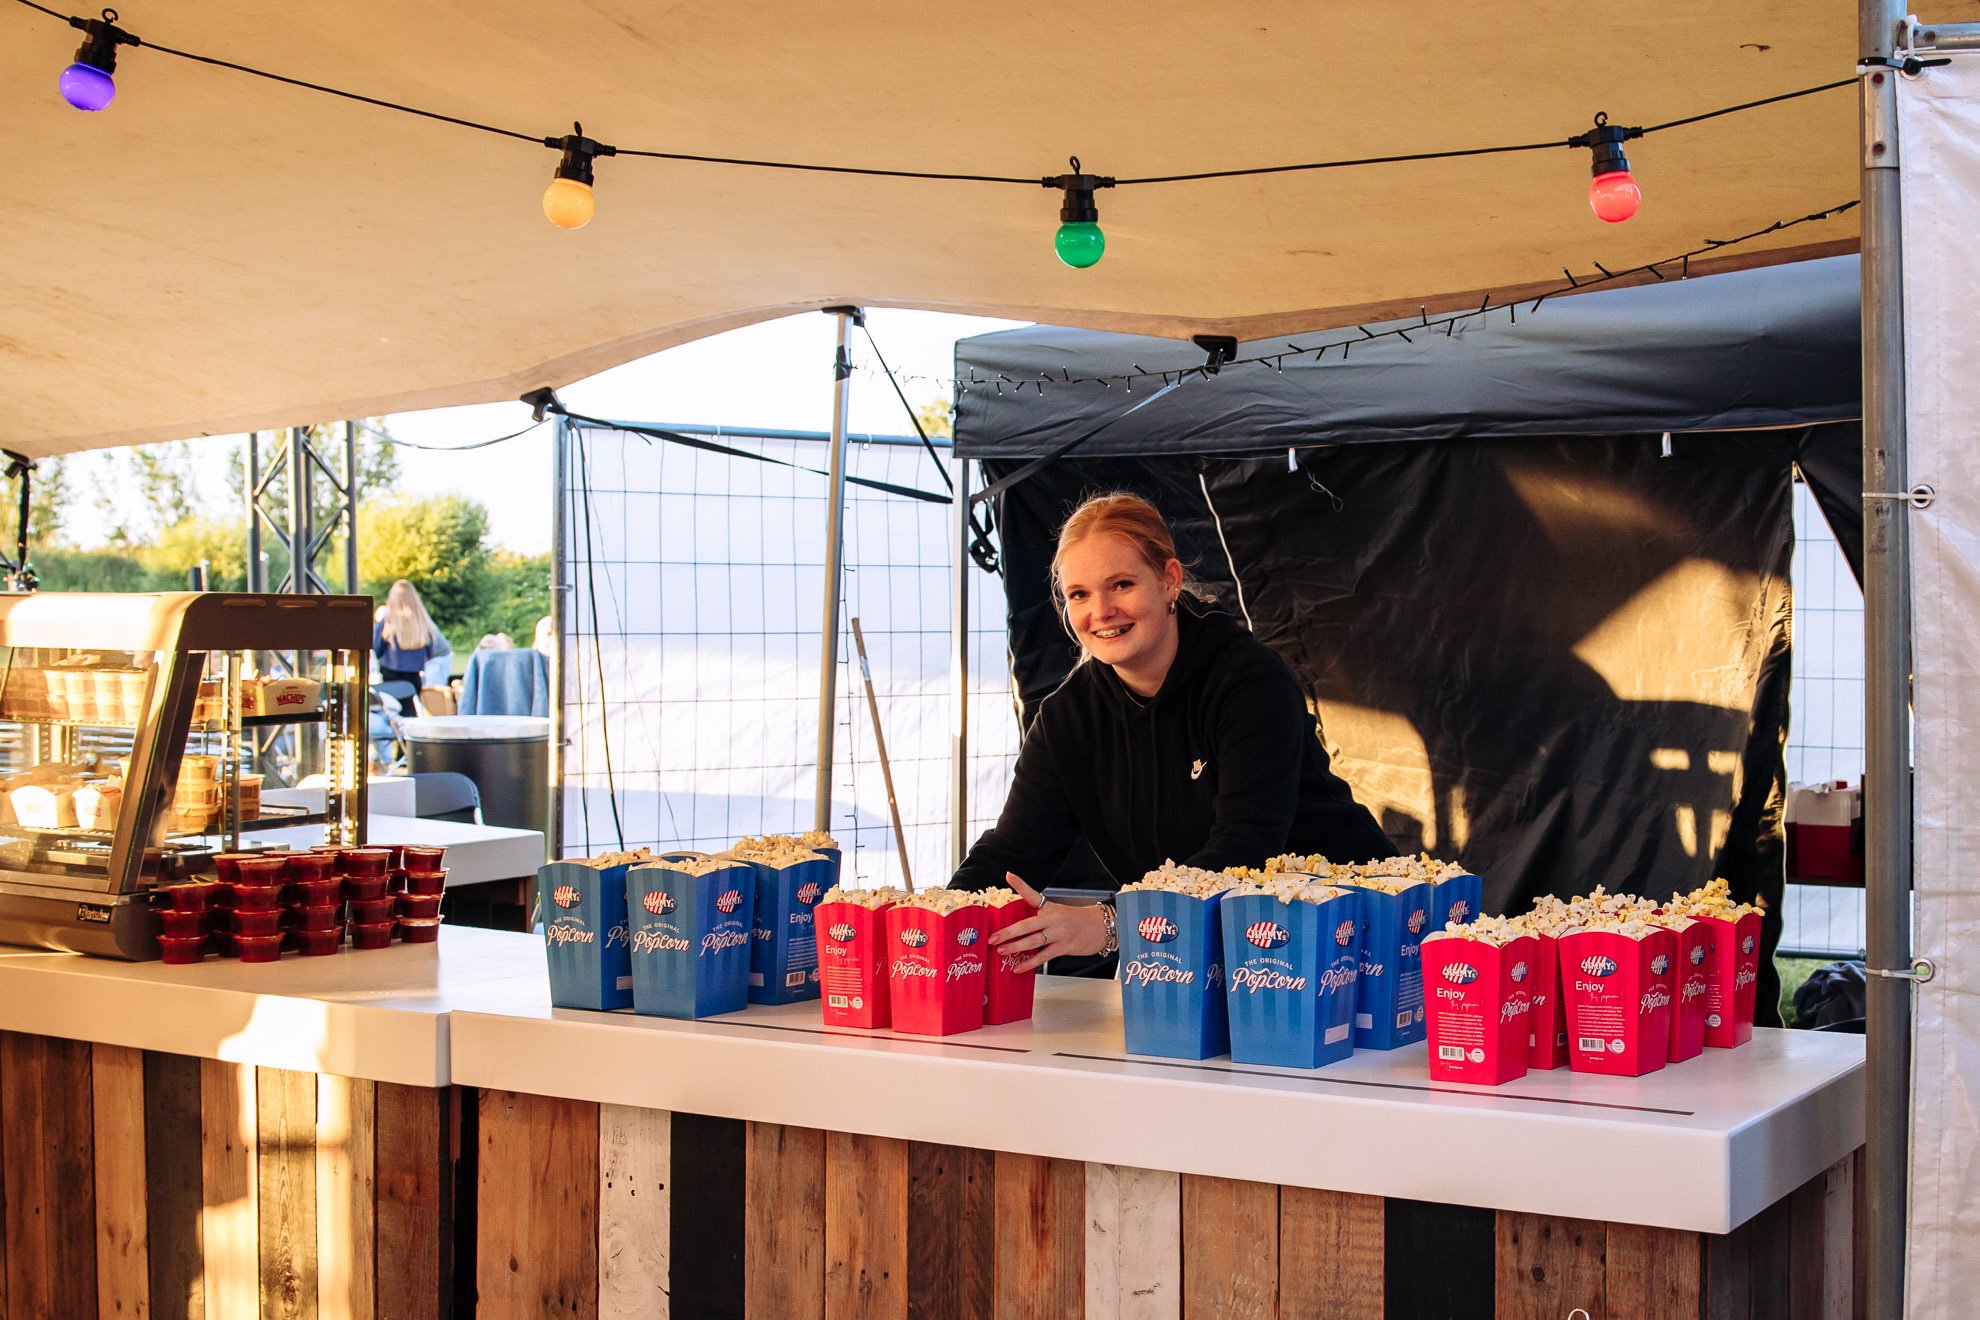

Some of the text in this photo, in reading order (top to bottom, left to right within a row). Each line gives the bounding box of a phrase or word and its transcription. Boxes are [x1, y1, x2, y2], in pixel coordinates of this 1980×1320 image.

[276, 693, 307, 706] NACHOS
[563, 915, 586, 927] ORIGINAL
[790, 912, 813, 924] Enjoy
[654, 923, 680, 934] ORIGINAL
[713, 924, 723, 932] THE
[825, 945, 847, 957] Enjoy
[1401, 943, 1419, 957] Enjoy
[1137, 951, 1182, 964] THE ORIGINAL
[1244, 957, 1293, 970] THE ORIGINAL
[1575, 980, 1604, 993] Enjoy
[1437, 987, 1465, 1000] Enjoy
